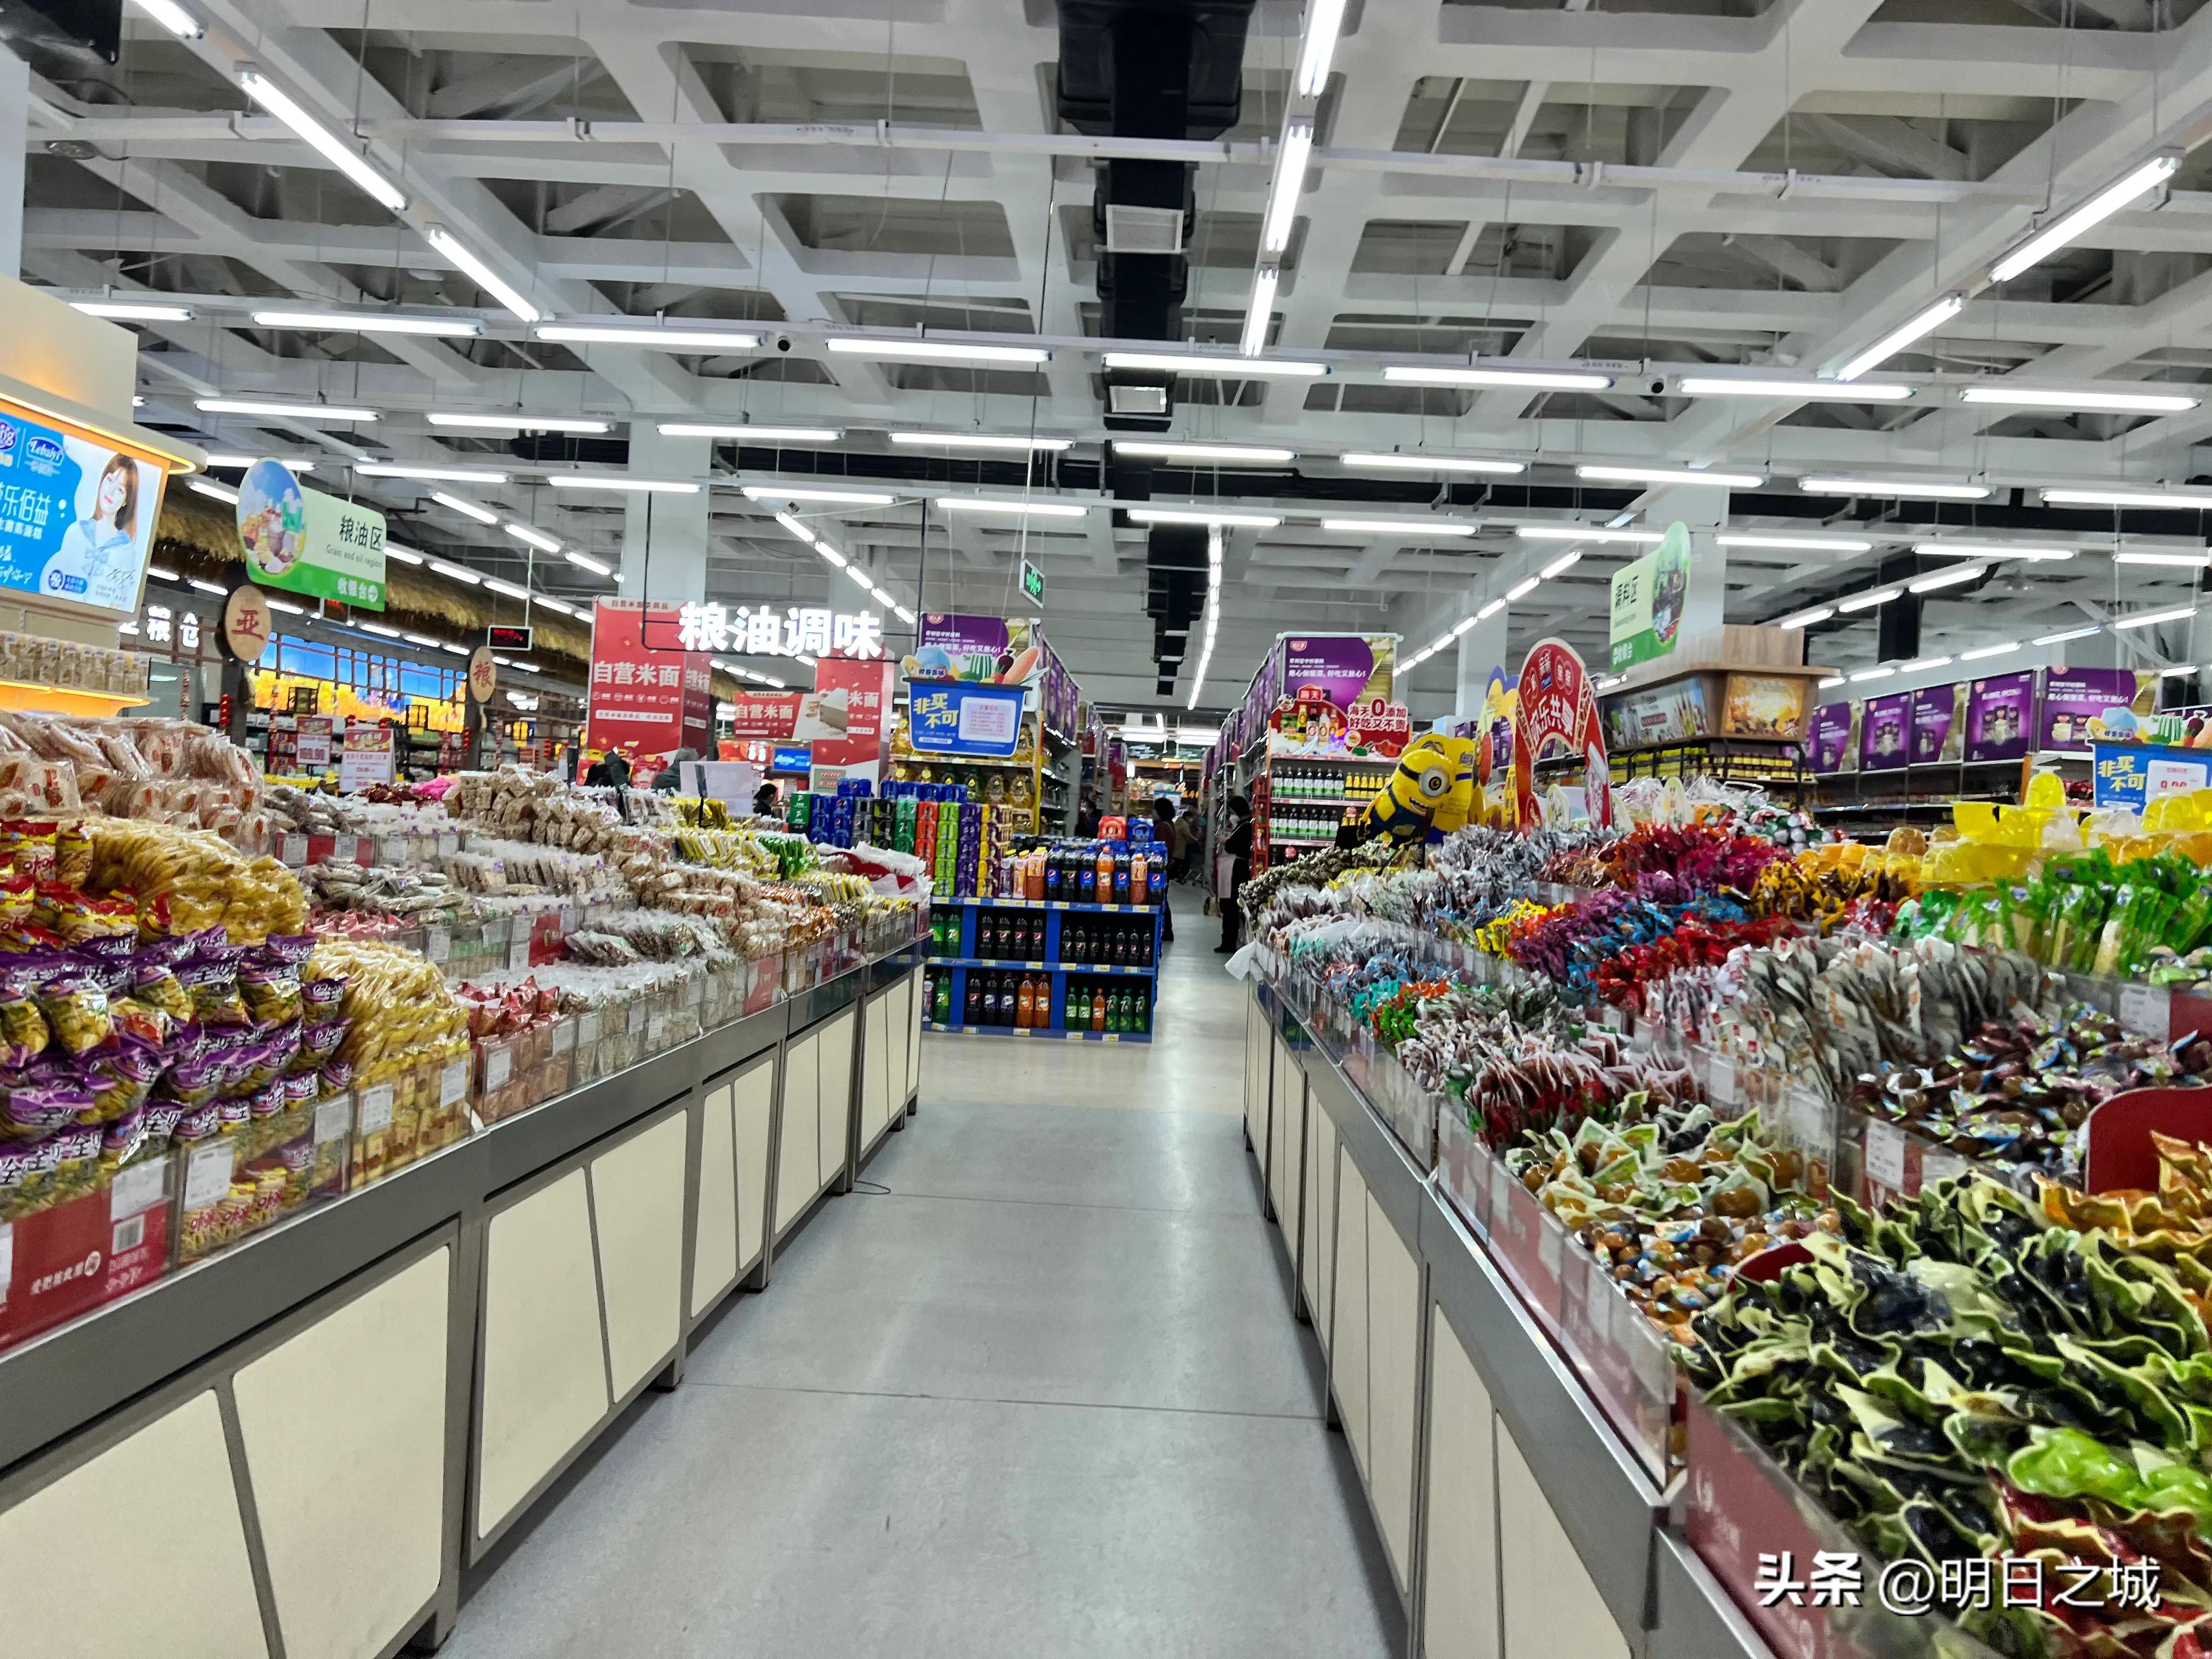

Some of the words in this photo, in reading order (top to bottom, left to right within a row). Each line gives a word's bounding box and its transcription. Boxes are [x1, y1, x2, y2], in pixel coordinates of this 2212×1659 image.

[0, 482, 51, 526] 乐佰益
[340, 515, 383, 551] 粮油区
[232, 610, 264, 640] 亚
[678, 601, 882, 660] 粮油调味
[473, 661, 493, 687] 粮
[594, 661, 681, 687] 自营米面
[735, 704, 794, 720] 自营米面
[913, 693, 948, 714] 非买
[924, 710, 959, 729] 不可
[1350, 718, 1406, 730] 好吃又不贵
[2098, 756, 2134, 777] 非买
[2109, 774, 2146, 792] 不可
